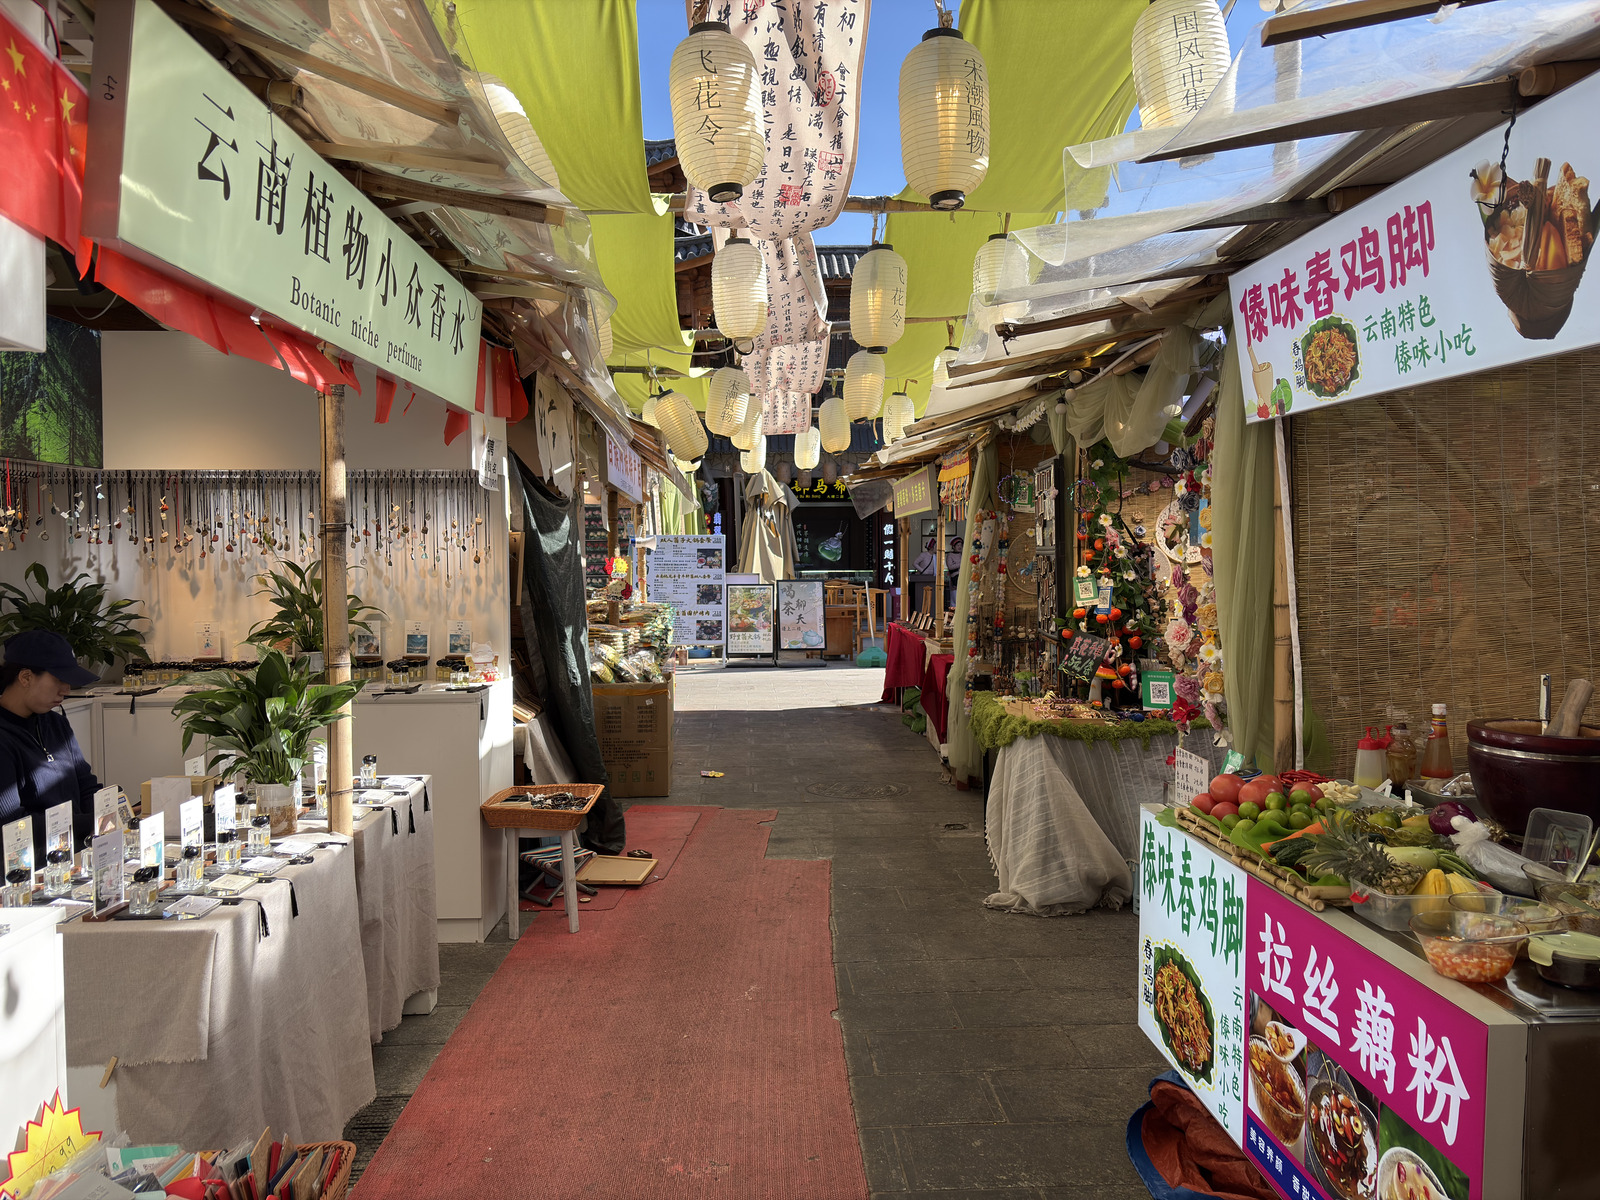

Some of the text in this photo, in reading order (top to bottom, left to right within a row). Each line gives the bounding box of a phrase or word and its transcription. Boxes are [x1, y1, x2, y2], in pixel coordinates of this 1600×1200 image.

[103, 75, 117, 101] 40
[691, 49, 723, 145] 飞花令
[1172, 10, 1206, 113] 国风市集
[194, 92, 465, 356] 云南植物小众香水
[290, 276, 423, 373] Botanic niche perfume
[890, 266, 905, 328] 飞花令
[1362, 294, 1437, 343] 云南特色
[1394, 323, 1477, 376] 傣味小吃
[781, 584, 796, 617] 喝茶
[1218, 1013, 1229, 1130] 傣味小吃
[1231, 986, 1243, 1102] 云南特色
[1257, 911, 1471, 1146] 拉丝藕粉
[1291, 1174, 1317, 1200] 香甜
